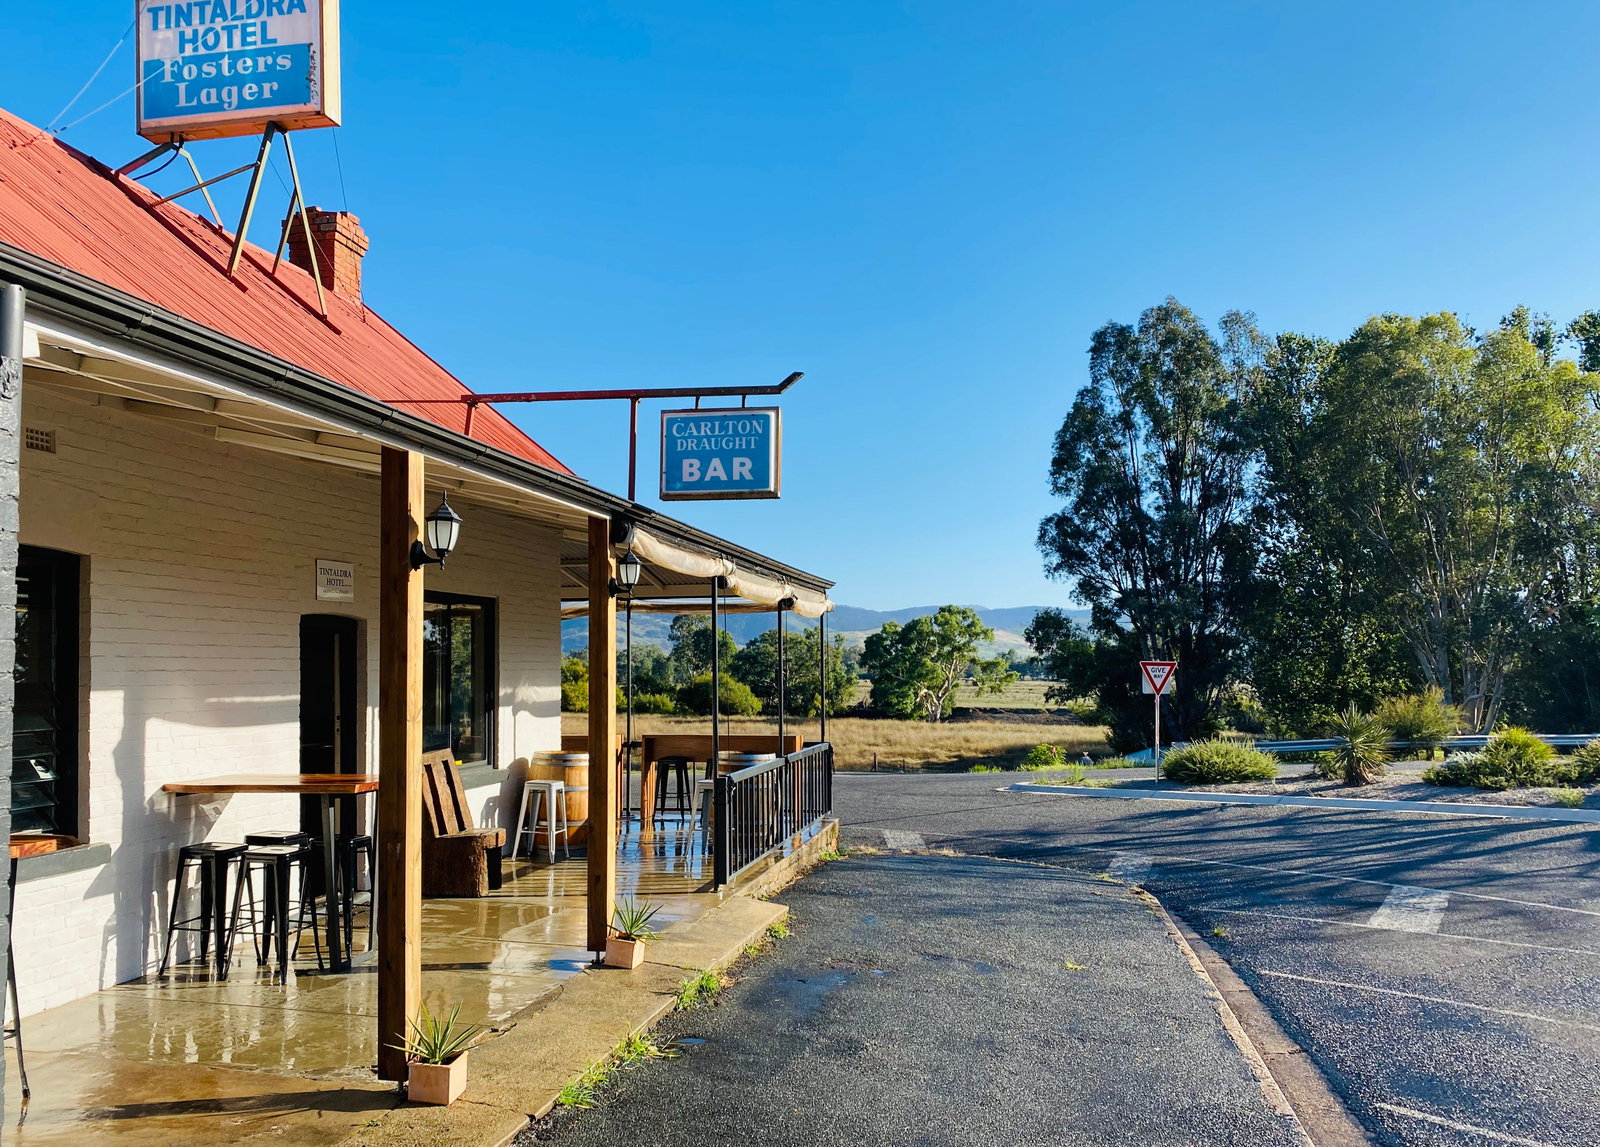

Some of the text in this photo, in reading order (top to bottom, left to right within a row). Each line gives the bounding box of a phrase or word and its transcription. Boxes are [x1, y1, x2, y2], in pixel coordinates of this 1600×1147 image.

[147, 0, 307, 31] TINTALDRA
[178, 21, 277, 54] HOTEL
[160, 52, 292, 83] Foster's
[175, 81, 279, 110] Lager
[672, 419, 764, 437] CARLTON
[676, 436, 759, 451] DRAUGHT
[682, 456, 754, 482] BAR
[319, 567, 352, 578] TINTALDRA
[326, 578, 345, 587] HOTEL
